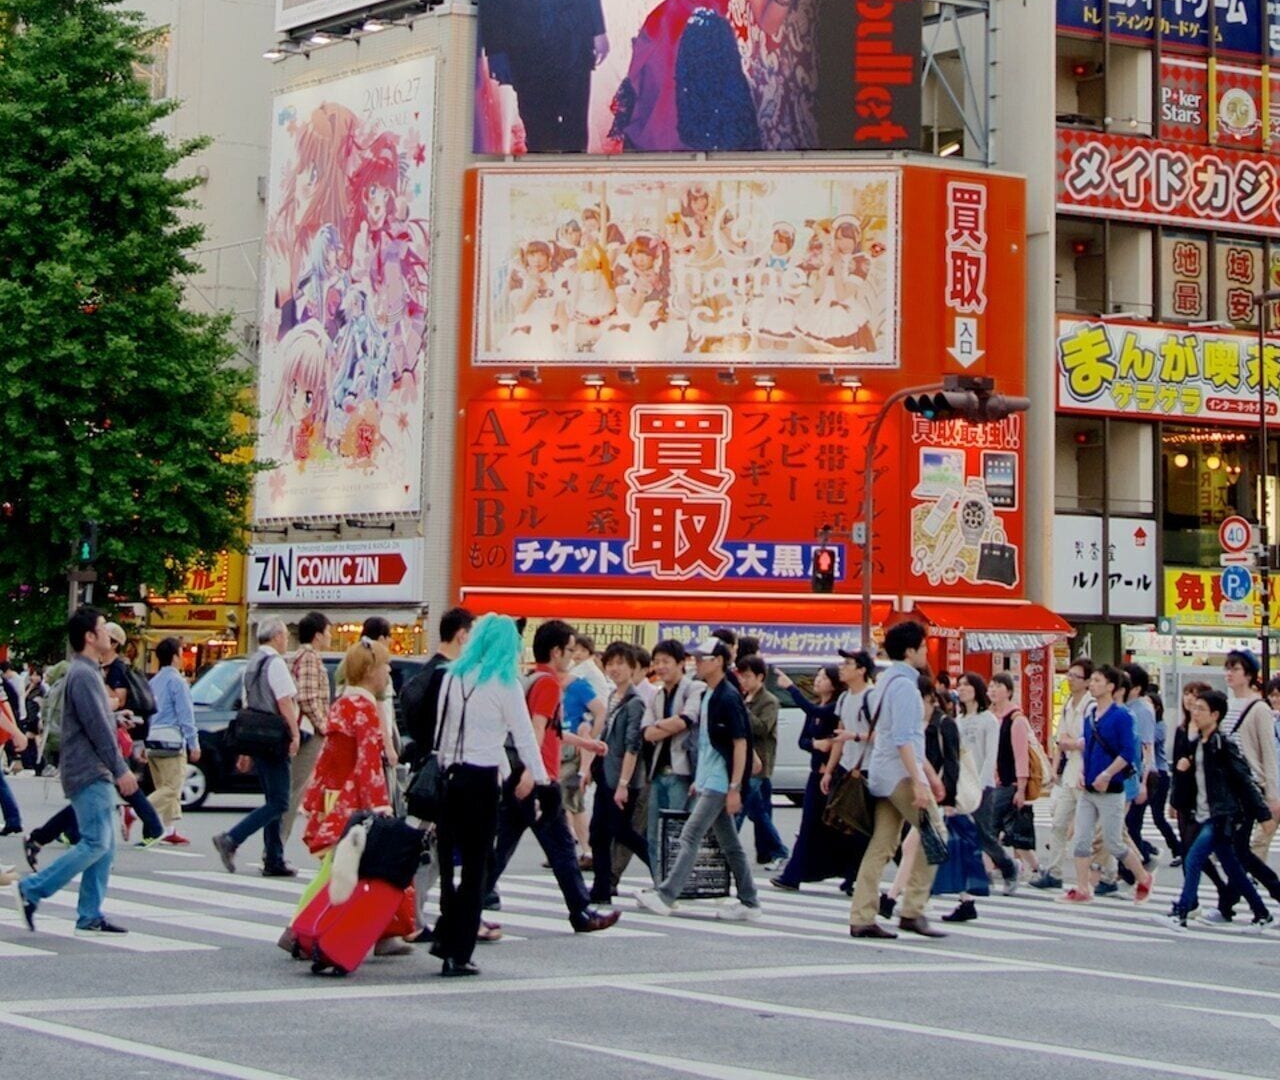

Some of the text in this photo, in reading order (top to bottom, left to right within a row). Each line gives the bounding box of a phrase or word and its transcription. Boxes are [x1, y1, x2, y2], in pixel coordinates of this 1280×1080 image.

[362, 76, 421, 114] 2014.6.27
[1162, 103, 1202, 125] Stars
[946, 179, 988, 314] 買取
[959, 322, 973, 356] 入口
[519, 409, 548, 530] アイドル
[553, 410, 584, 501] アニメ
[586, 409, 623, 534] 美少女系
[737, 411, 775, 537] フィギュア
[777, 409, 811, 502] ホビー
[470, 407, 511, 571] AKBもの
[626, 404, 732, 580] 買取
[1227, 527, 1244, 543] 40
[255, 547, 293, 598] ZIN
[298, 556, 379, 585] COMIC ZIN
[515, 541, 621, 574] チケット
[295, 588, 342, 600] Akihabara
[1072, 571, 1152, 592] ルノアール
[1227, 574, 1241, 598] P
